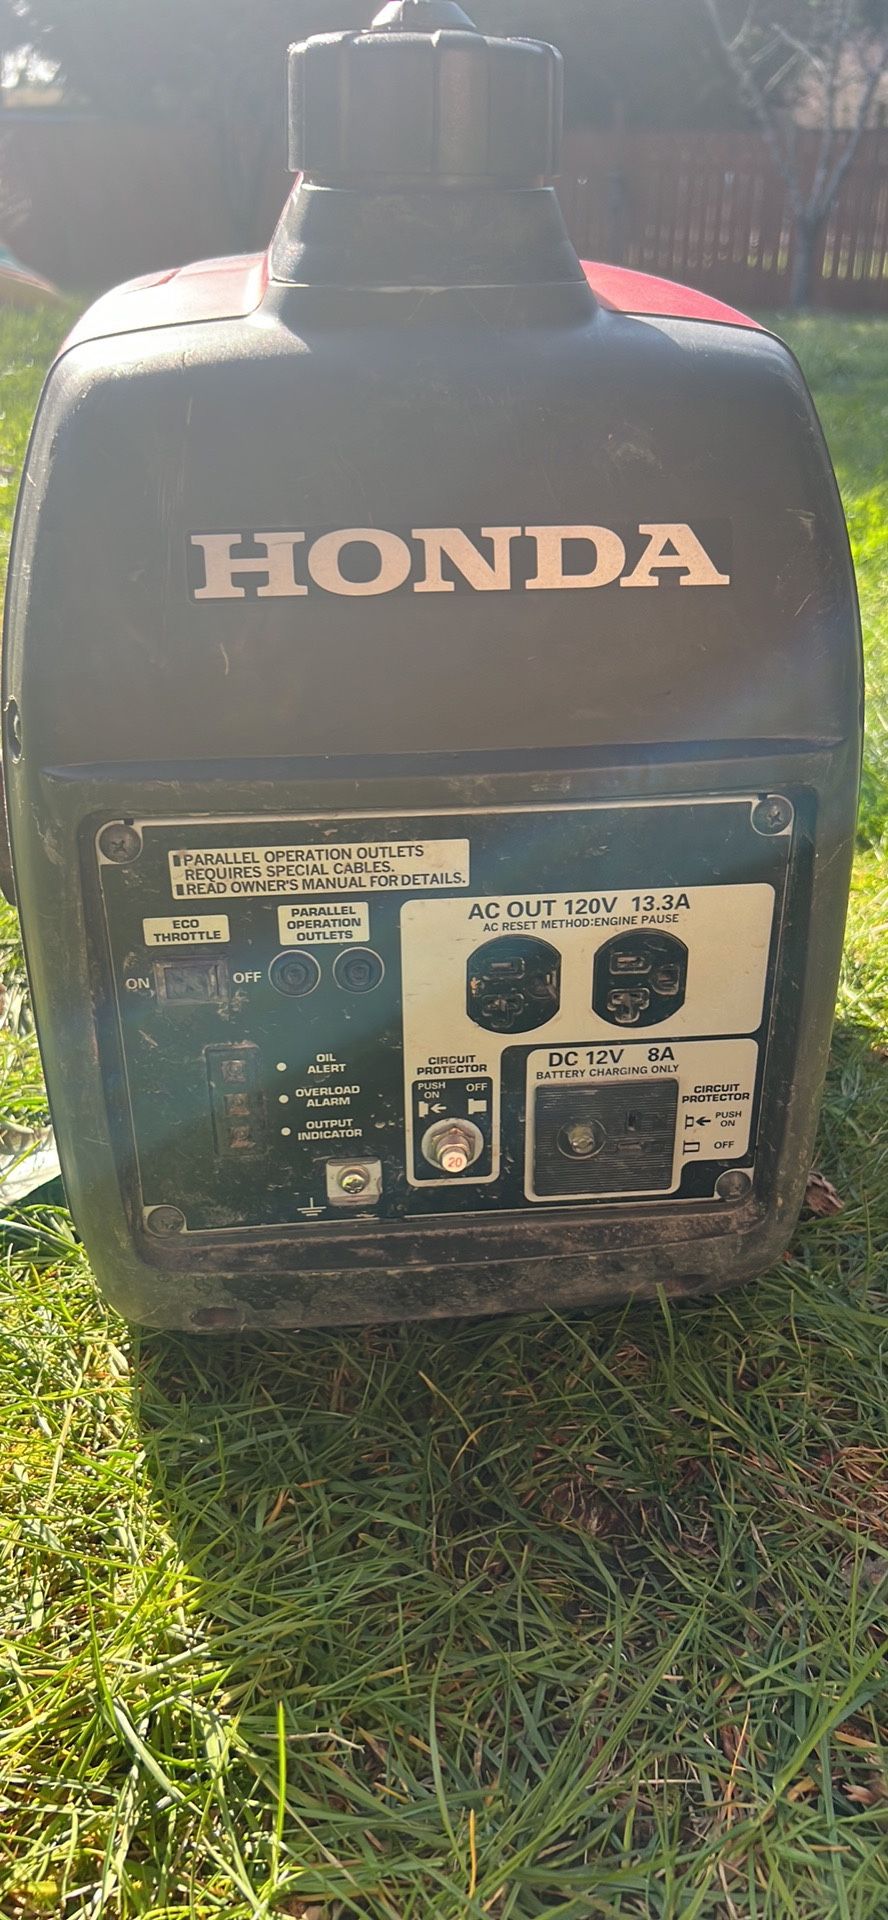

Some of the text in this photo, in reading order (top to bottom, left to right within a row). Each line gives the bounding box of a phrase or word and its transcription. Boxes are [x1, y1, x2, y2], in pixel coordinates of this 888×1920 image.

[190, 523, 730, 599] HONDA
[183, 845, 425, 867] PARALLEL OPERATION OUTLETS
[184, 861, 395, 882] REQUIRES SPECIAL CABLES.
[186, 872, 466, 896] READ OWNER'S MANUAL FOR DETAILS.
[290, 906, 356, 918] PARALLEL
[468, 893, 691, 920] AC OUT 120V 13.3A
[172, 919, 200, 930] ECO
[287, 917, 361, 930] OPERATION
[483, 913, 679, 932] AC RESET METHOD:ENGINE PAUSE
[153, 930, 221, 943] THROTTLE
[296, 929, 353, 942] OUTLETS
[125, 977, 150, 990] ON
[232, 971, 262, 985] OFF
[316, 1053, 337, 1063] OIL
[427, 1055, 477, 1065] CIRCUIT
[548, 1046, 675, 1067] DC 12V 8A
[307, 1064, 346, 1074] ALERT
[416, 1064, 488, 1076] PROTECTOR
[536, 1064, 679, 1080] BATTERY CHARGING ONLY
[295, 1085, 361, 1097] OVERLOAD
[417, 1081, 446, 1091] PUSH
[466, 1082, 488, 1092] OFF
[693, 1083, 740, 1093] CIRCUIT
[424, 1091, 440, 1099] ON
[682, 1092, 750, 1103] PROTECTOR
[306, 1097, 350, 1107] ALARM
[715, 1110, 742, 1119] PUSH
[306, 1118, 353, 1129] OUTPUT
[720, 1119, 736, 1127] ON
[297, 1129, 363, 1141] INDICATOR
[713, 1140, 735, 1150] OFF
[447, 1156, 463, 1168] 20
